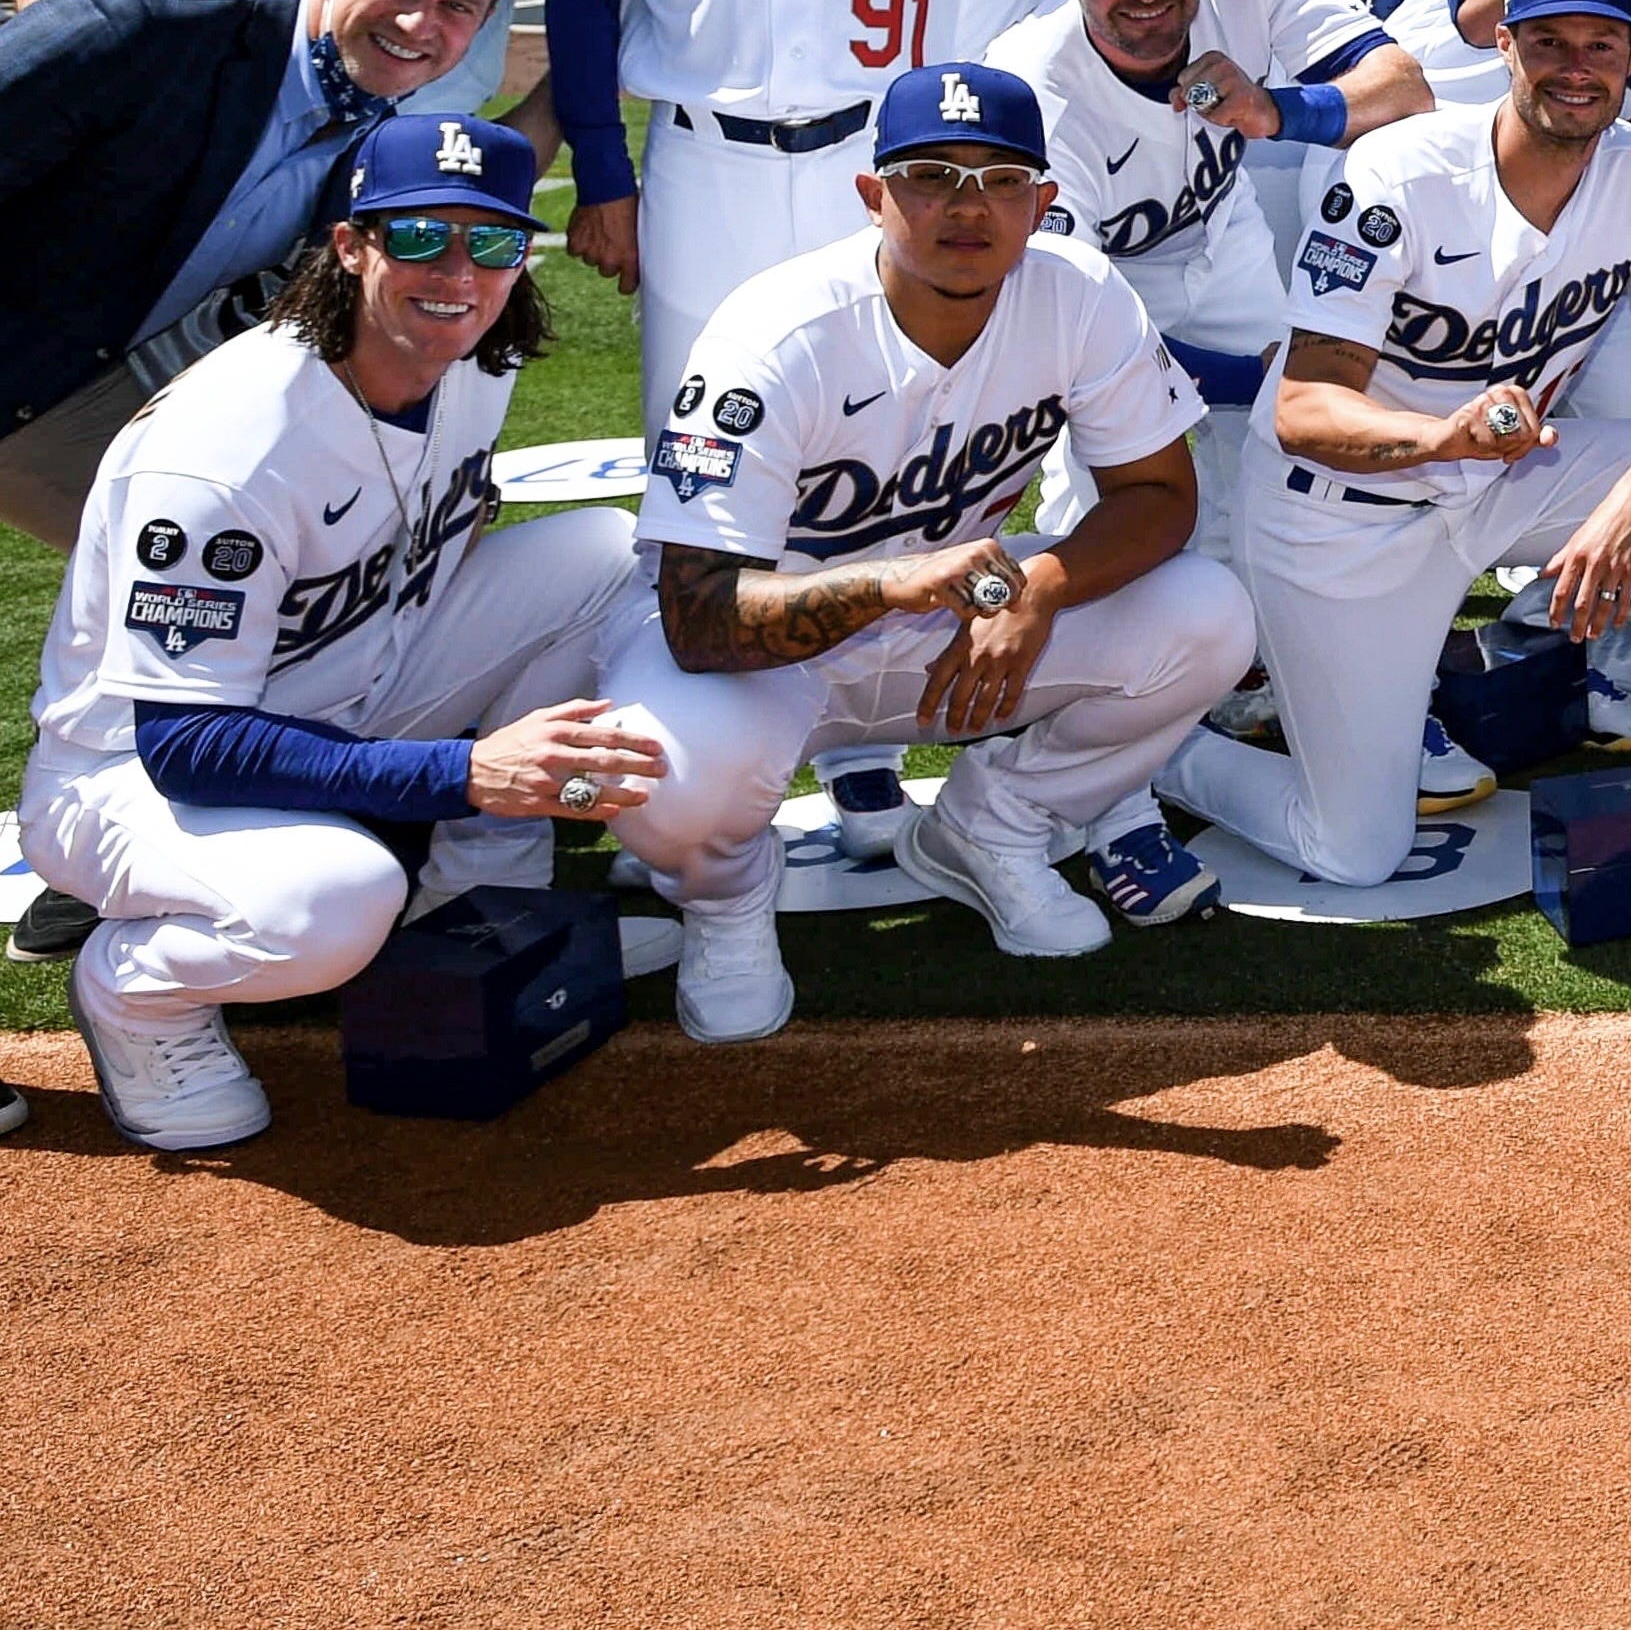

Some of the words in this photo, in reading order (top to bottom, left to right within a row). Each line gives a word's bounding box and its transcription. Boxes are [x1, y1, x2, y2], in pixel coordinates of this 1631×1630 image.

[940, 73, 979, 120] LA
[436, 122, 481, 174] LA
[1362, 214, 1394, 243] 20
[1304, 247, 1363, 283] CHAMPIONS
[1388, 259, 1631, 390] Dodgers
[717, 400, 754, 430] 20
[150, 535, 170, 561] 2
[215, 537, 255, 548] SUTTON
[211, 546, 252, 572] 20
[134, 591, 185, 606] WORLD
[187, 597, 237, 612] SERIES
[131, 602, 236, 630] CHAMPIONS
[165, 625, 187, 653] LA
